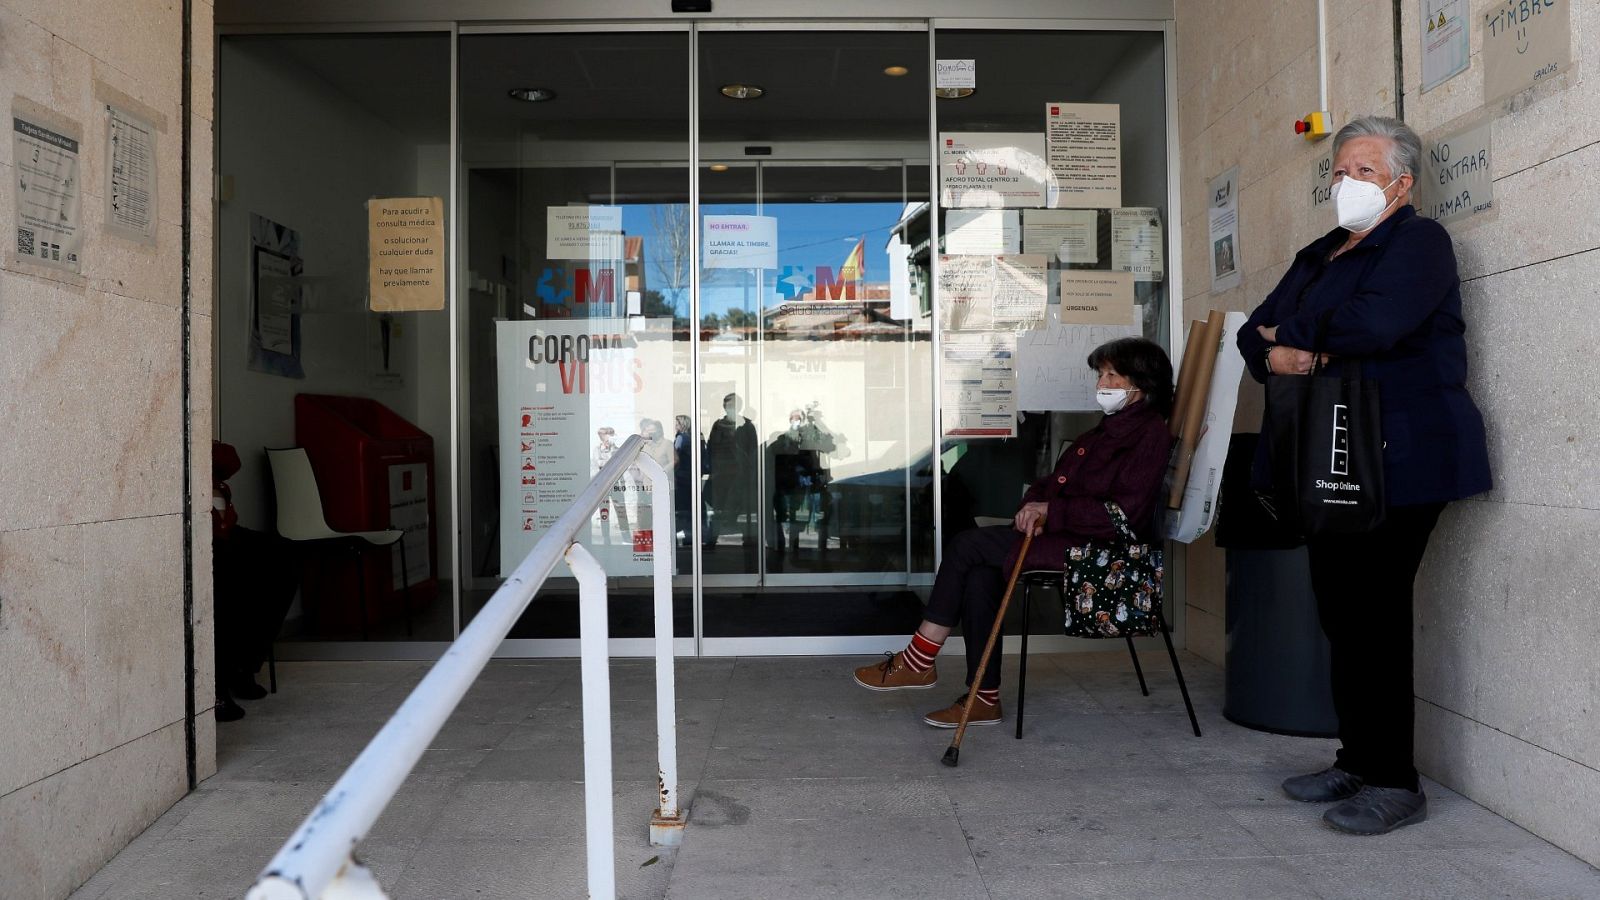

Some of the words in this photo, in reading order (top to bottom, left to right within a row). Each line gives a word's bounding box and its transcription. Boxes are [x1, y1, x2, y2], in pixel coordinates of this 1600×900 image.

[1431, 143, 1450, 168] NO
[1318, 158, 1330, 175] NO
[1439, 149, 1489, 185] ENTRAR,
[382, 208, 399, 216] Para
[400, 208, 422, 216] acudir
[376, 219, 407, 228] consulta
[408, 218, 436, 226] médica
[390, 236, 429, 244] solucionar
[379, 249, 413, 257] cualquier
[414, 248, 434, 256] duda
[379, 267, 393, 276] hay
[393, 268, 409, 276] que
[409, 267, 433, 275] llamar
[575, 268, 615, 304] M
[528, 333, 626, 365] CORONA
[558, 358, 644, 395] VIRUS
[1316, 480, 1339, 491] Shop
[1340, 482, 1360, 490] Online
